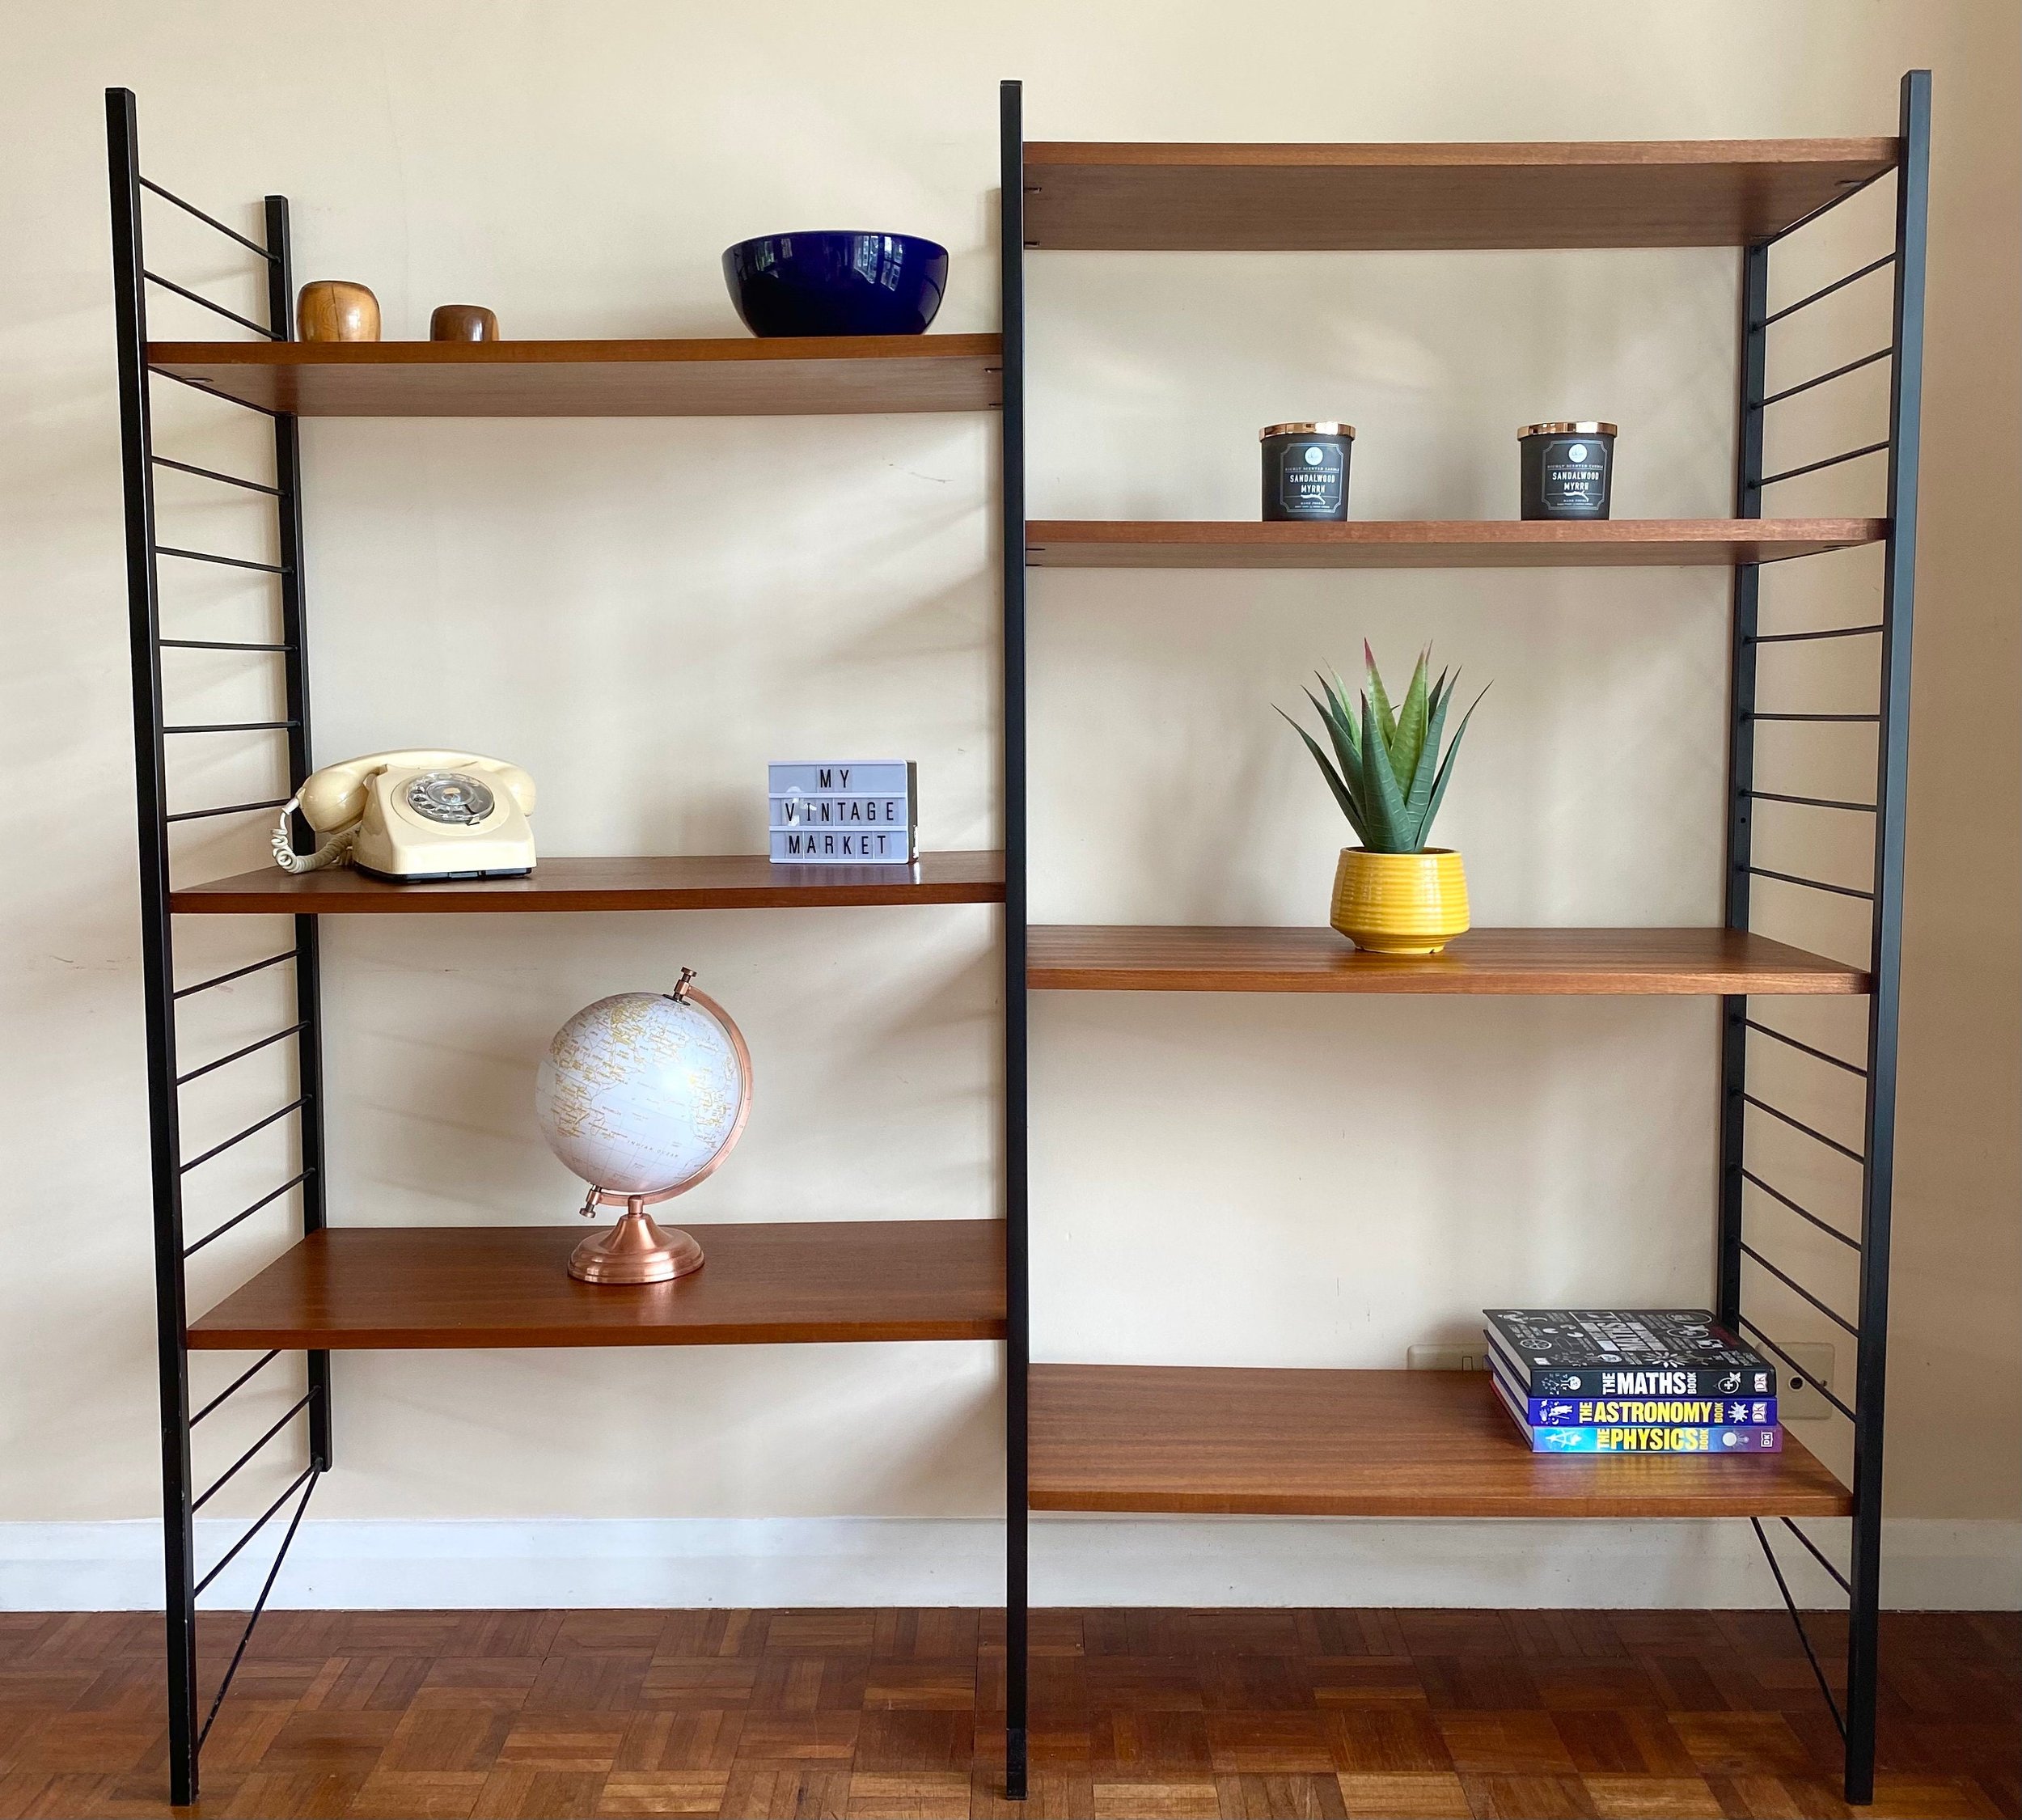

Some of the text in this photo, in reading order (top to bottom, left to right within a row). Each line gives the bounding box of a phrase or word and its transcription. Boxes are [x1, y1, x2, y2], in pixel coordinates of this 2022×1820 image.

[1289, 474, 1335, 483] SANDALWOOD
[1552, 472, 1599, 480] SANDALWOOD
[1301, 485, 1326, 493] MYRRH
[1563, 482, 1589, 490] MYRRH
[820, 769, 849, 788] MY
[785, 802, 894, 822] VINTAGE
[789, 835, 886, 855] MARKET
[1602, 1372, 1698, 1395] THE MATHS BOOK
[1755, 1373, 1766, 1391] DK
[1579, 1402, 1724, 1424] THE ASTRONOMY BOOK
[1753, 1403, 1766, 1421] DK
[1597, 1428, 1709, 1450] THE PHYSICS BOOK
